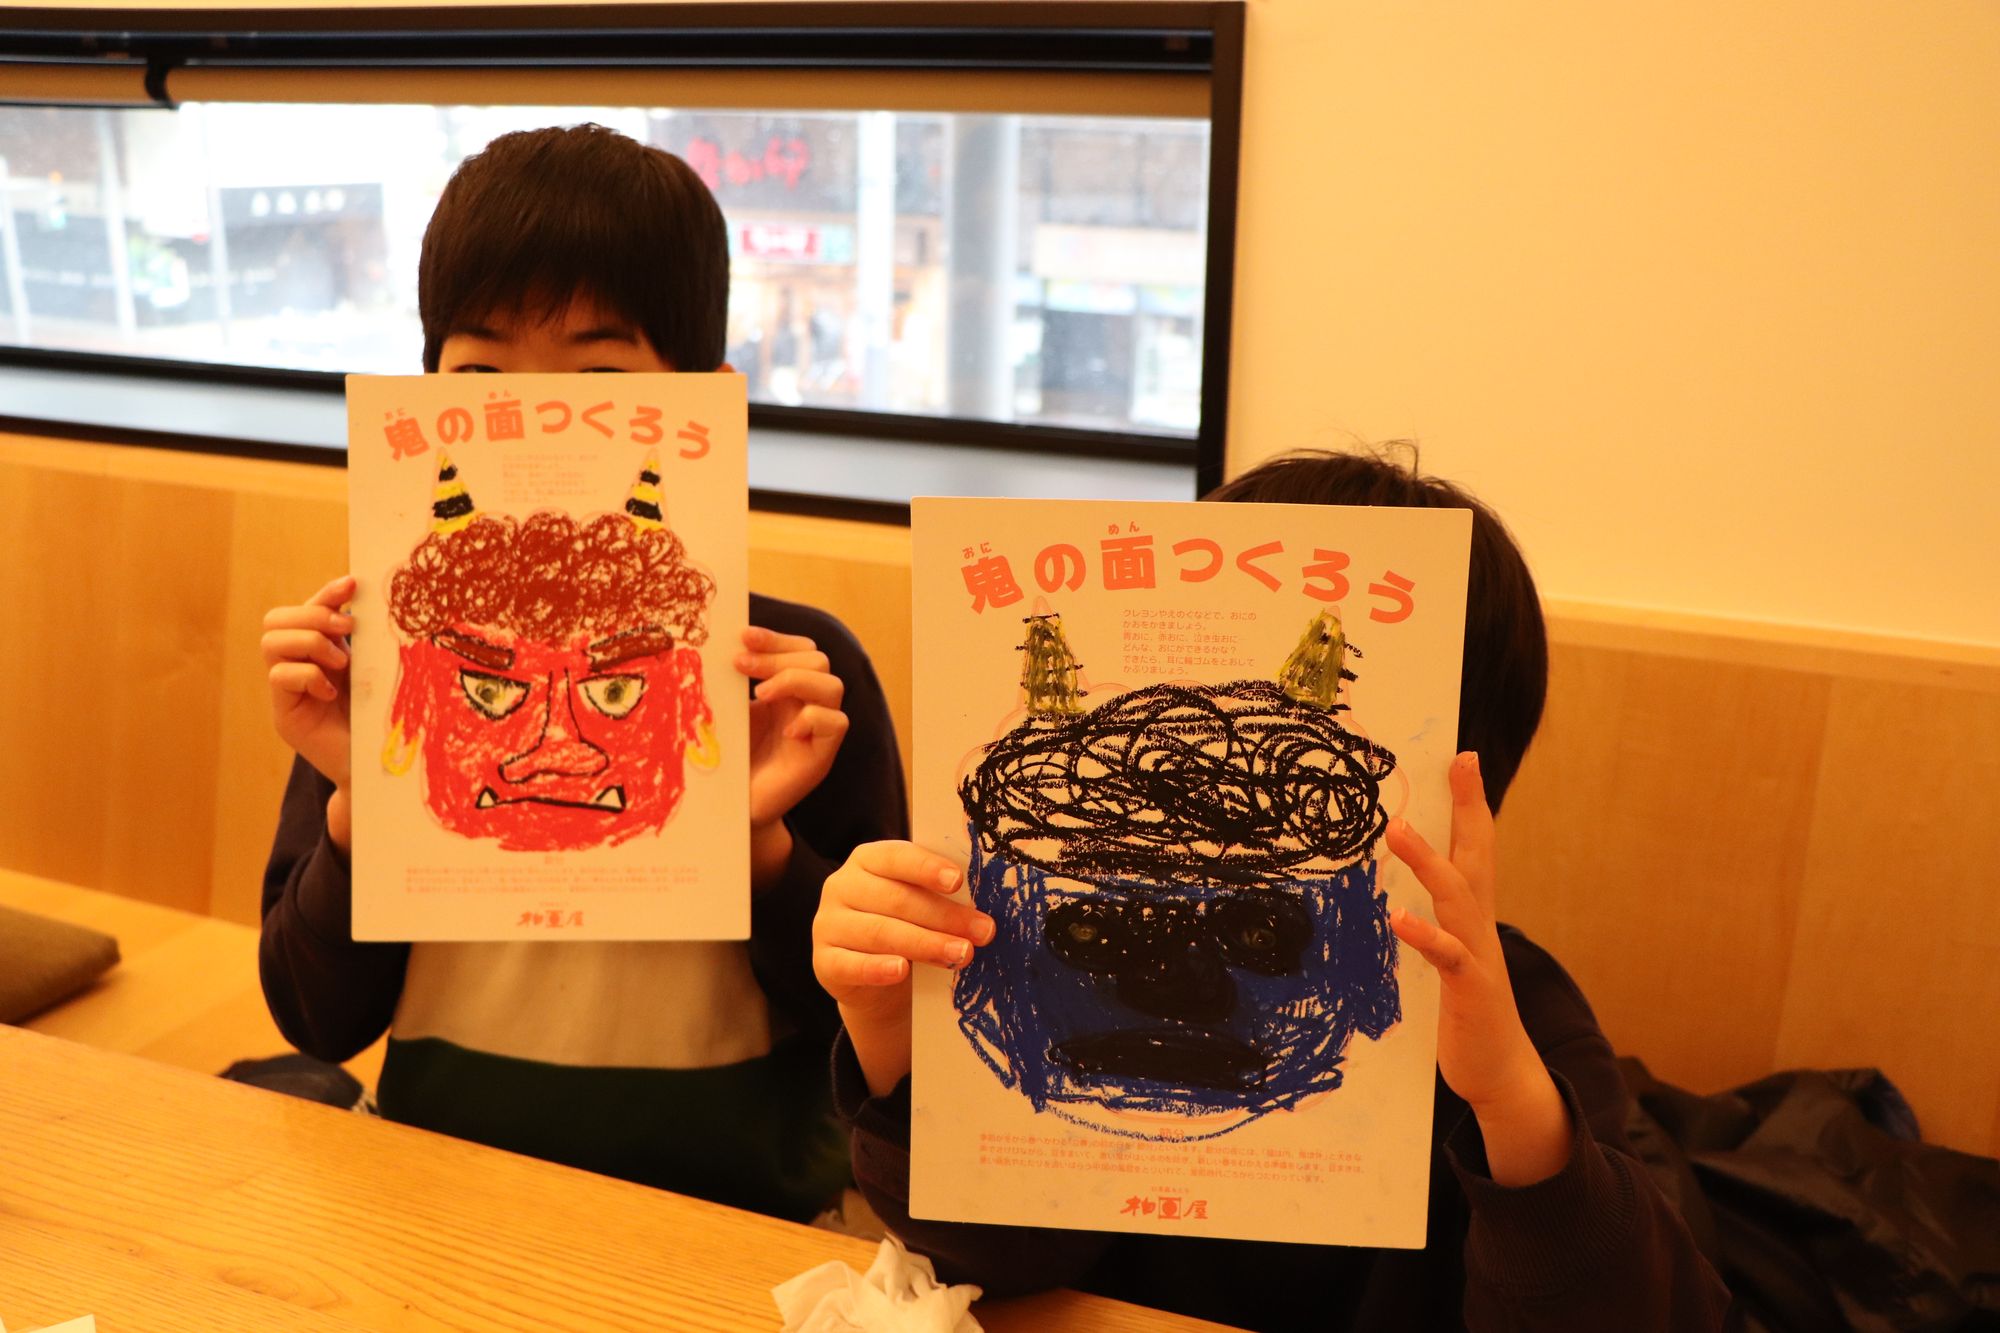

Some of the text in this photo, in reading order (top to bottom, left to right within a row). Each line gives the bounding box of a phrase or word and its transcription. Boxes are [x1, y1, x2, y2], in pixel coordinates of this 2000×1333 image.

[384, 399, 711, 462] 鬼の面つくろう
[1107, 520, 1140, 535] めん
[962, 541, 993, 560] おに
[961, 534, 1416, 624] 鬼の面つくろう
[1120, 1195, 1209, 1220] 柏屋
